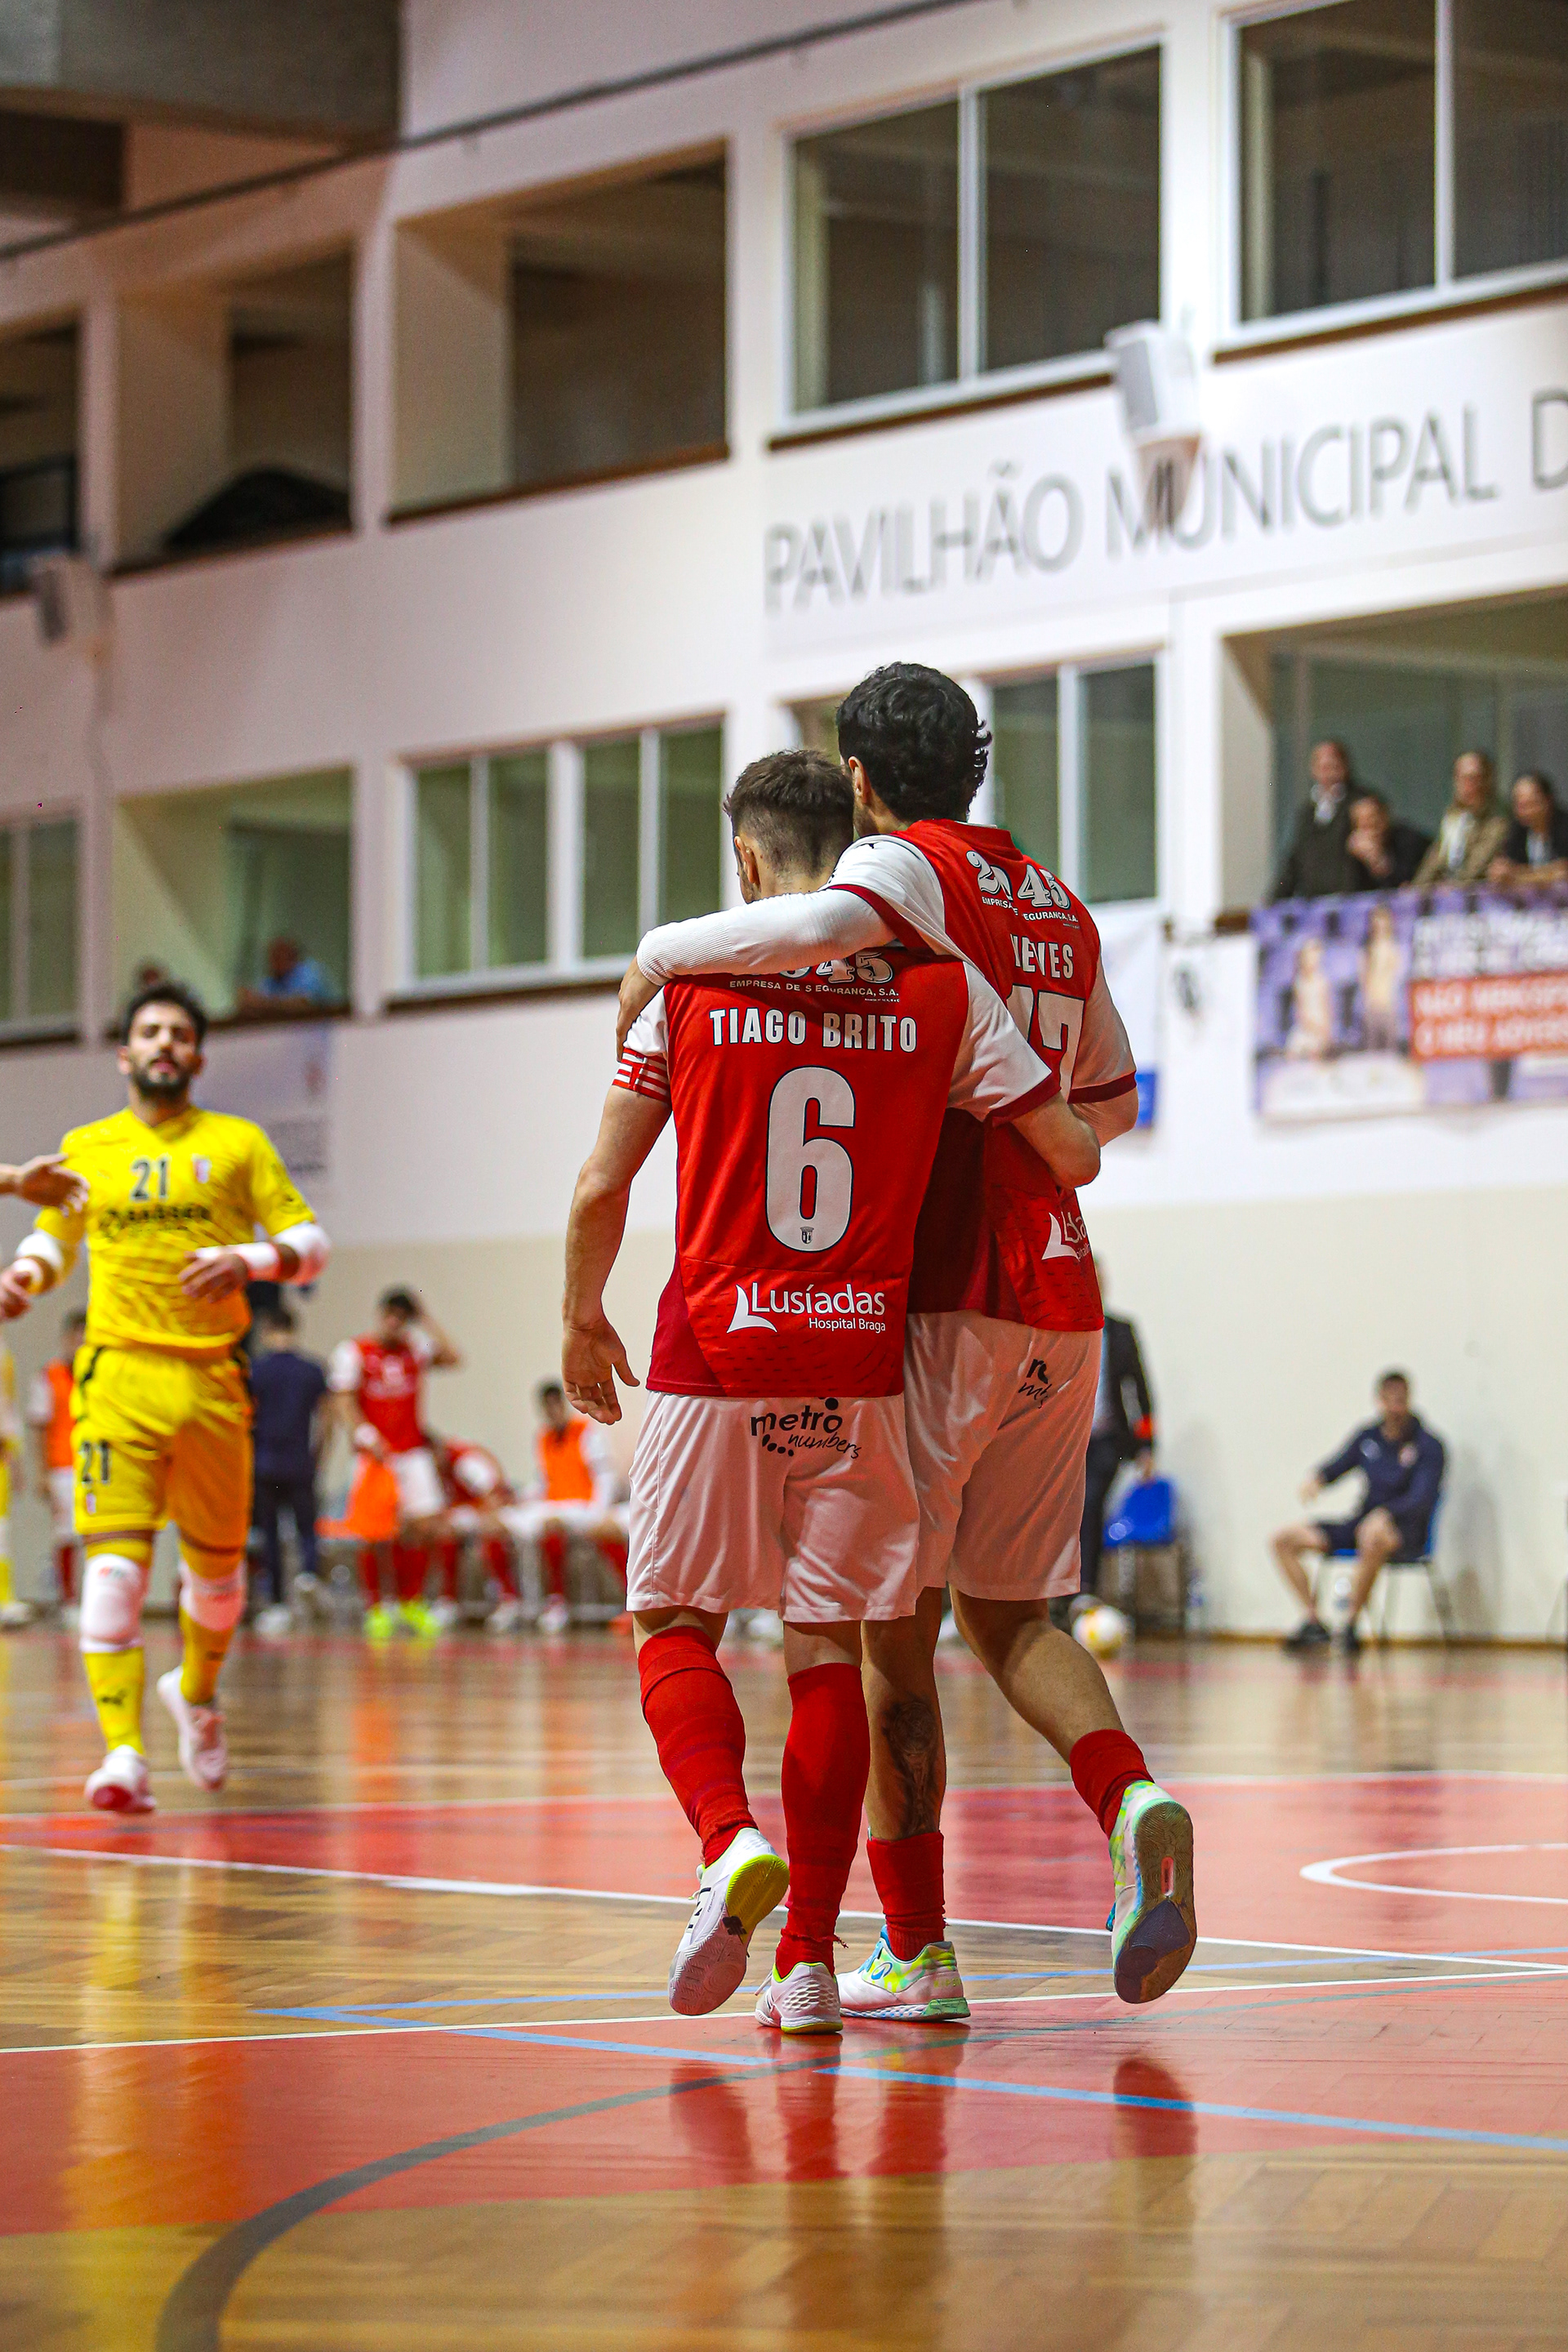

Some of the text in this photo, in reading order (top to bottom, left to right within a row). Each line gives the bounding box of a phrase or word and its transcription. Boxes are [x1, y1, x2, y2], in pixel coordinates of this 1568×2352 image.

[764, 459, 1085, 615] PAVILHÃO
[1107, 403, 1497, 559] MUNICIPAL
[1022, 909, 1068, 921] EGURANCA,
[779, 951, 893, 984] 45
[729, 979, 782, 990] EMPRESA
[786, 982, 800, 991] DE
[879, 988, 899, 996] S.A.
[709, 1007, 918, 1053] TIAGO BRITO
[766, 1066, 855, 1253] 6
[131, 1156, 169, 1201] 21
[751, 1282, 885, 1316] Lusíadas
[808, 1317, 886, 1333] Hospital Braga
[751, 1397, 843, 1436] metro
[80, 1440, 109, 1485] 21
[788, 1432, 862, 1459] numbers
